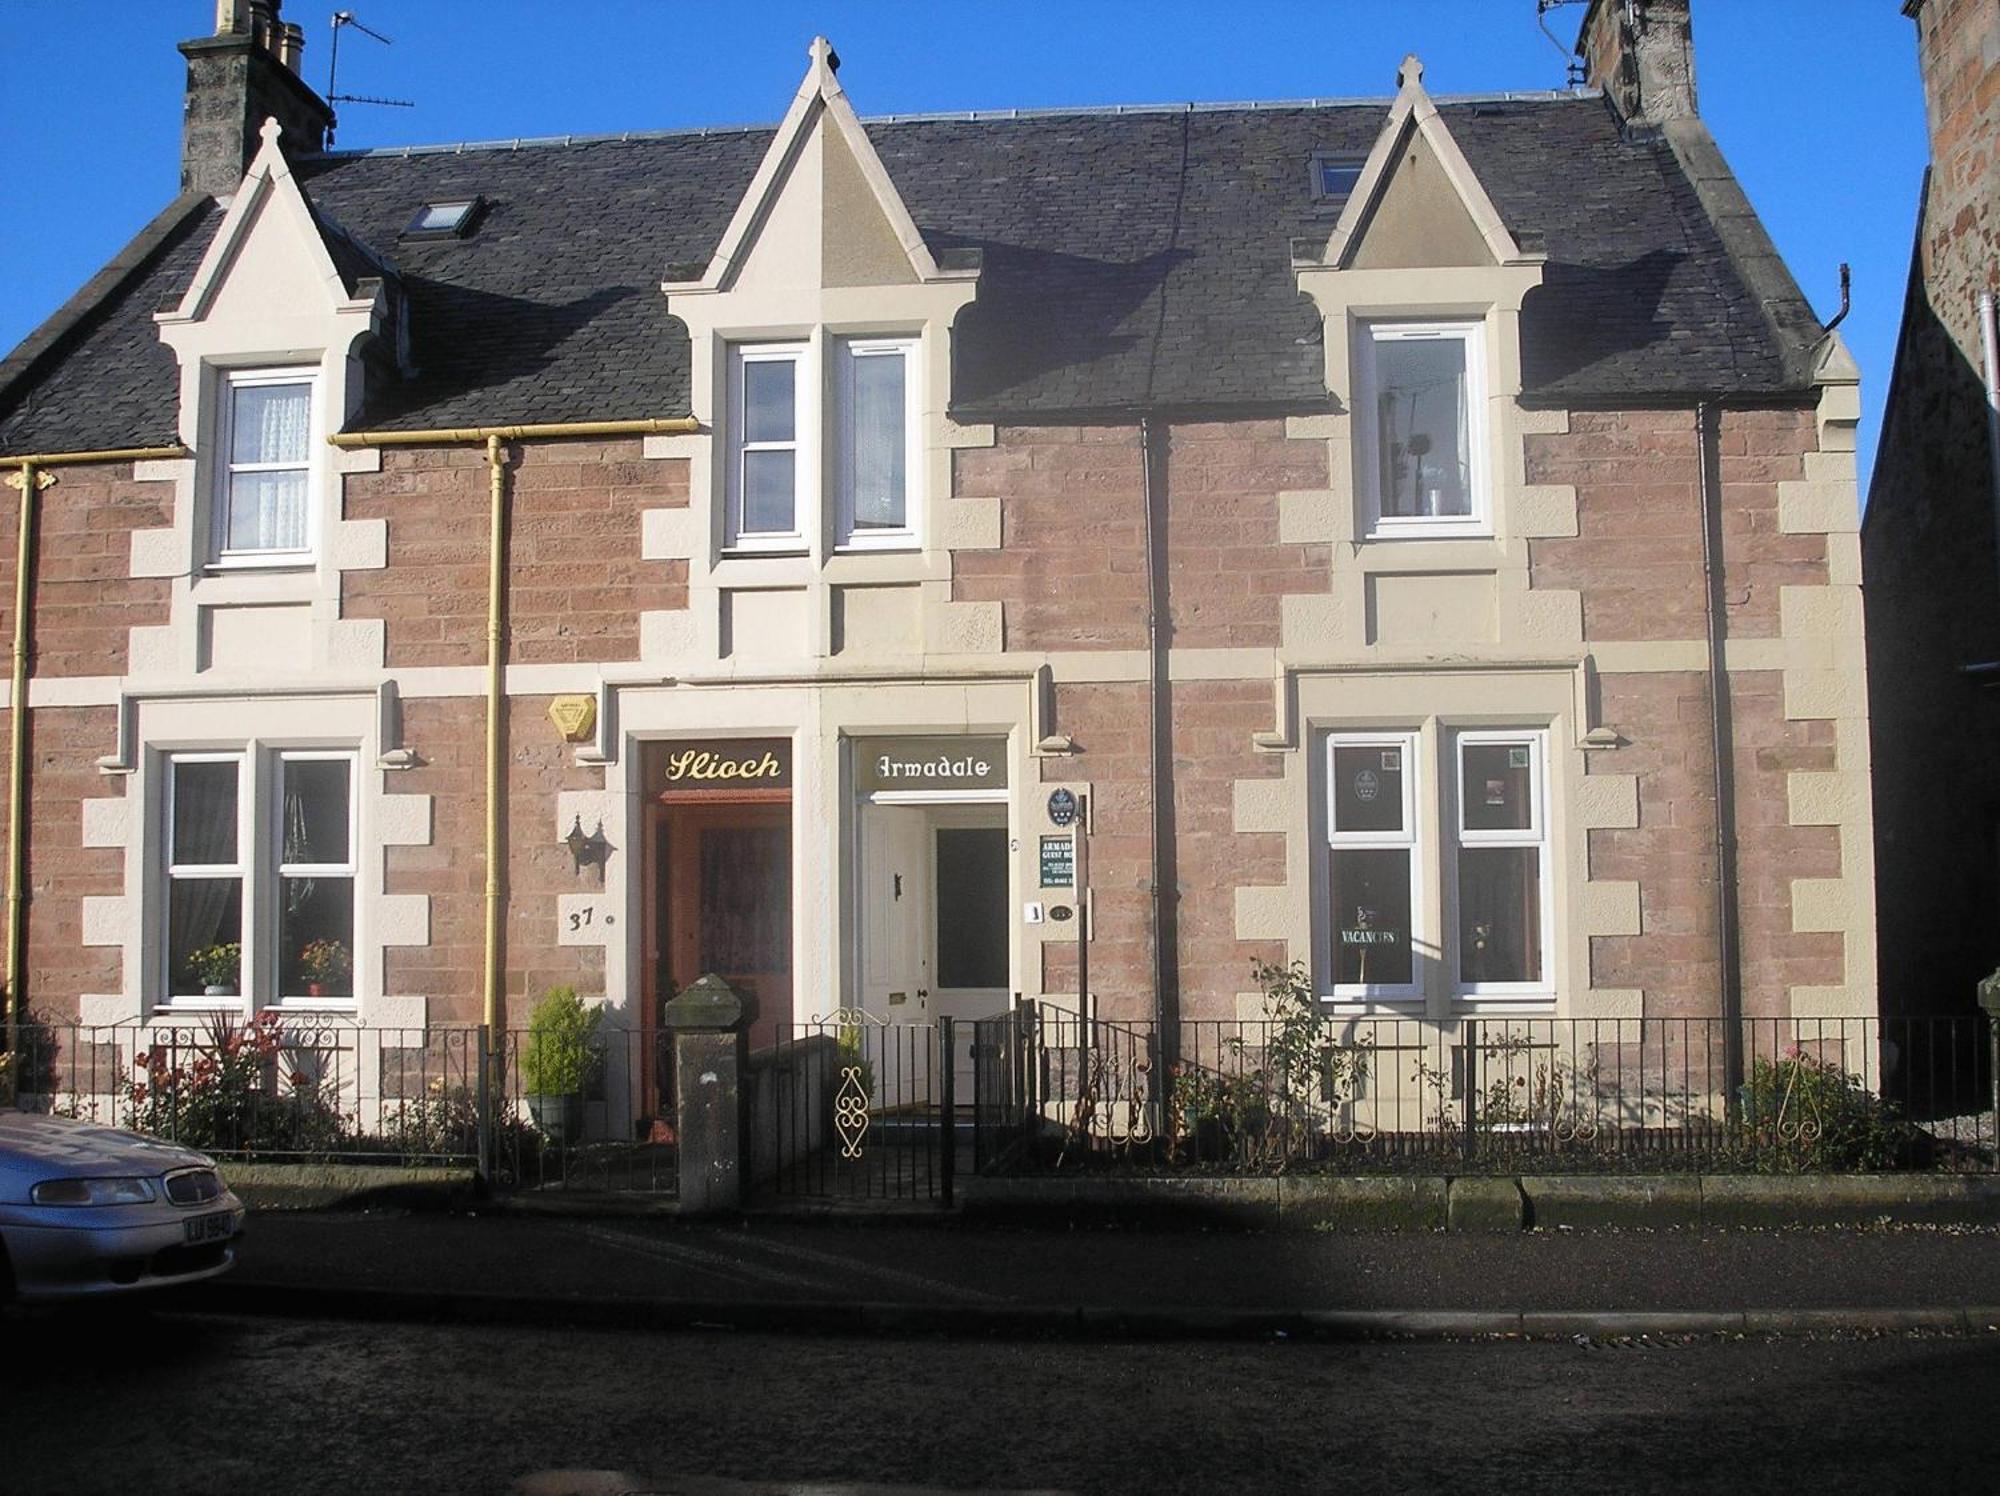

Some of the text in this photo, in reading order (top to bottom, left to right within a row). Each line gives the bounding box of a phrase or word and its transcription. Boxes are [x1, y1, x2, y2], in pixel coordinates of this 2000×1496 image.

[665, 750, 781, 781] Slioch
[878, 755, 992, 777] Armadale
[570, 907, 593, 931] 37
[1341, 930, 1395, 944] VACANCIES
